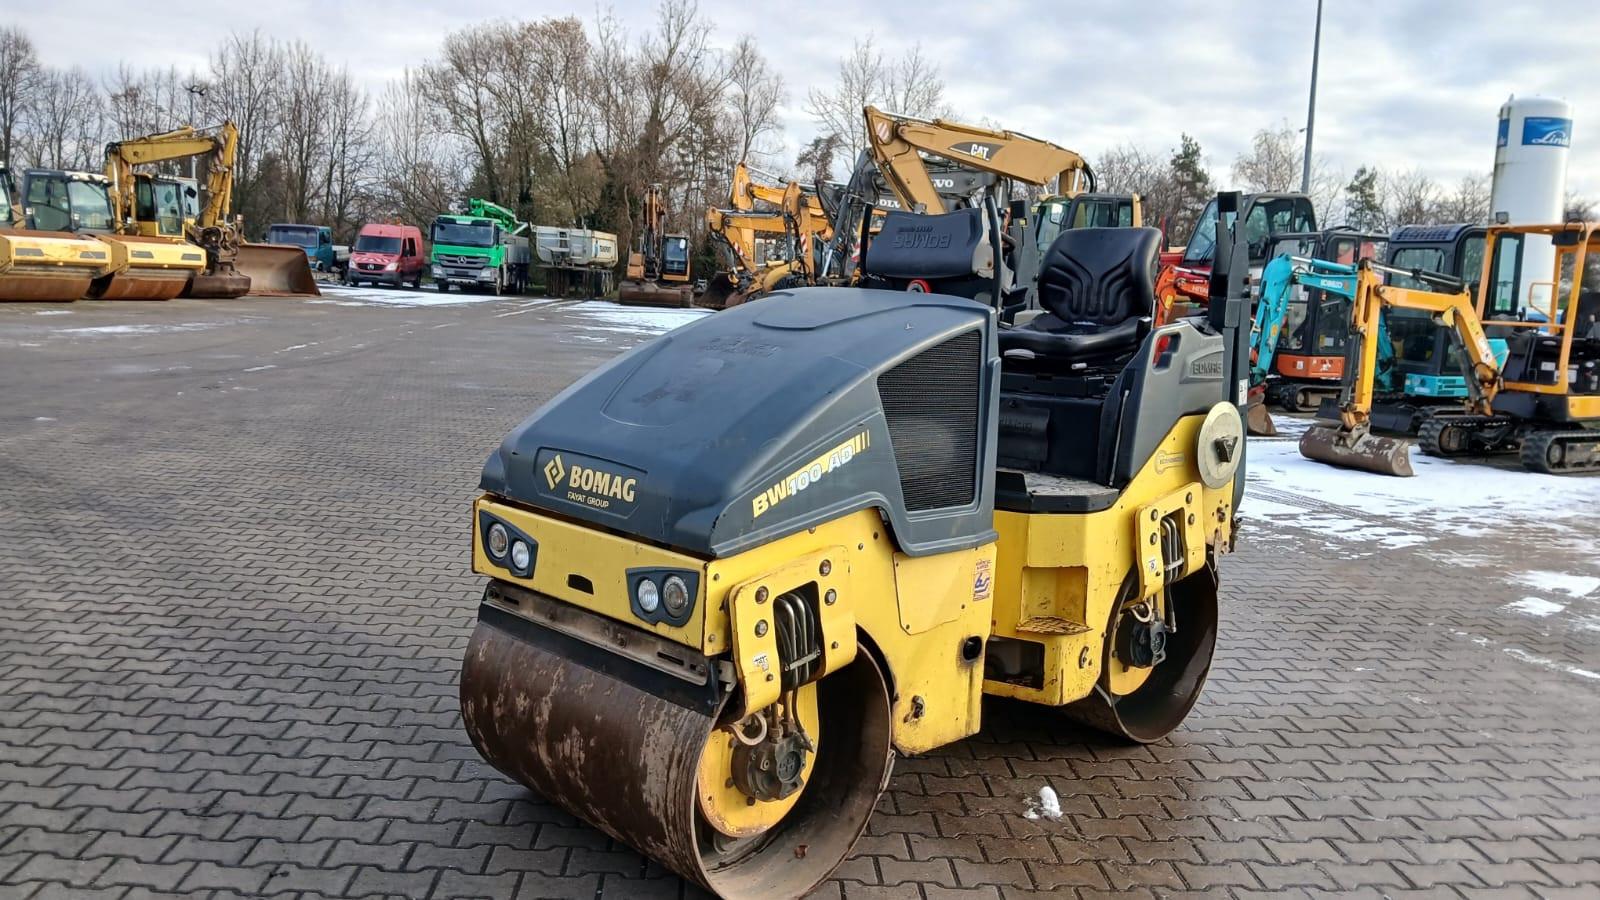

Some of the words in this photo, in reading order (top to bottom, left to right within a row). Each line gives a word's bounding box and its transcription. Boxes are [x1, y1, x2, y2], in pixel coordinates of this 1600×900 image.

[1532, 131, 1569, 145] Lind
[970, 143, 990, 160] CAT
[568, 465, 636, 502] BOMAG
[567, 491, 587, 502] FAYAT
[587, 496, 609, 508] GROUP
